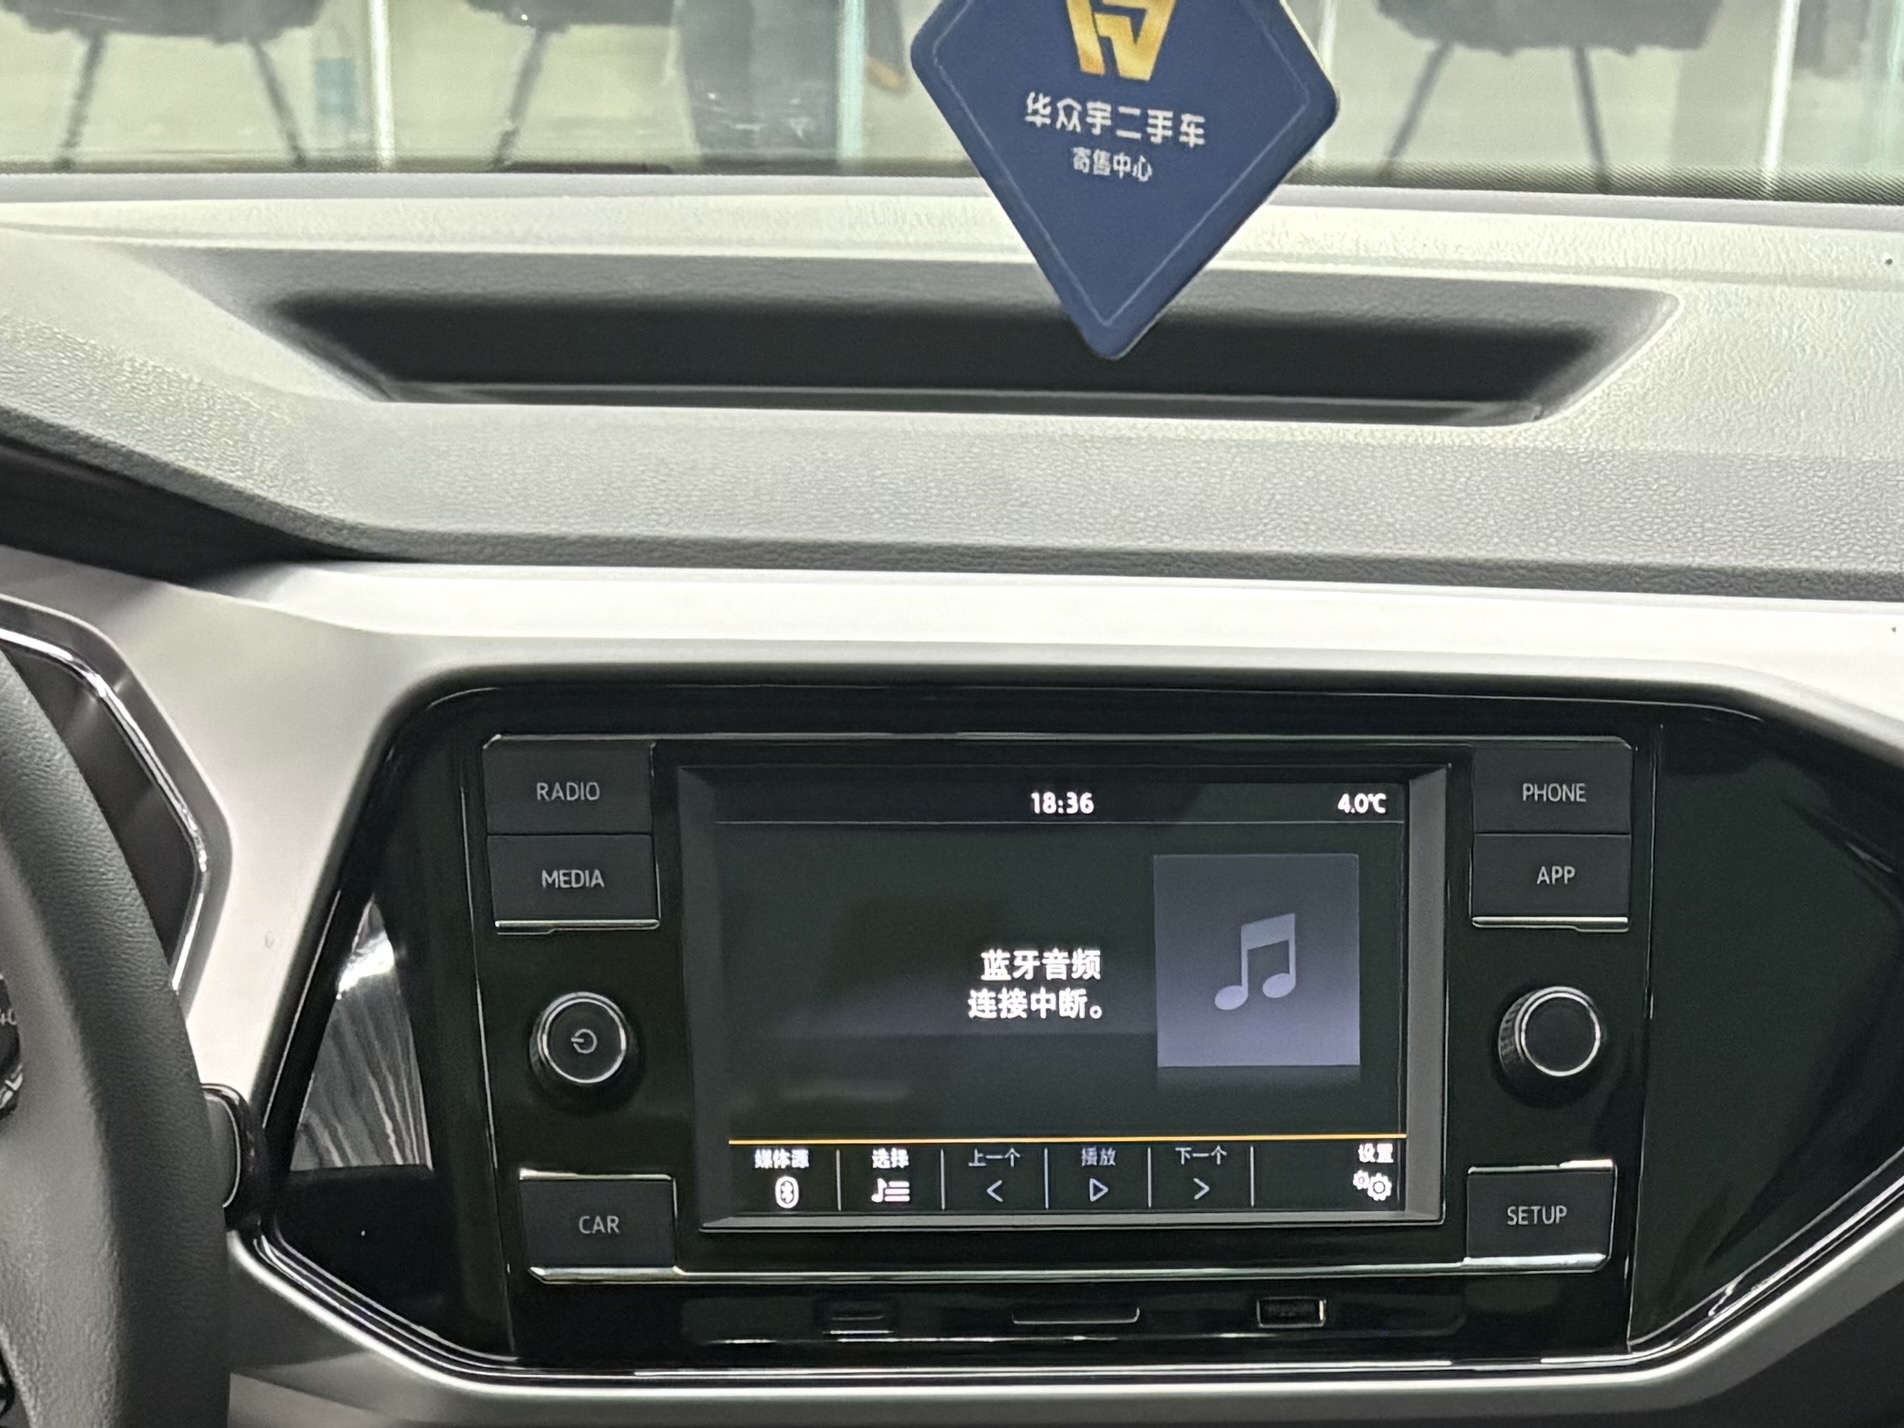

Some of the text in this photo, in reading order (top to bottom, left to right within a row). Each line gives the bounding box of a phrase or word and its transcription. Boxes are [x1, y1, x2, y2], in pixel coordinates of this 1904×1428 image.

[1024, 91, 1206, 148] 华众宇二手车
[1072, 146, 1153, 182] 寄售中心
[536, 782, 601, 802] RADIO
[1030, 790, 1095, 815] 18:36
[1522, 783, 1587, 803] PHONE
[541, 869, 605, 889] MEDIA
[1536, 866, 1576, 885] APP
[980, 947, 1102, 981] 蓝牙音频
[967, 985, 1103, 1019] 连接中断。
[872, 1148, 910, 1169] 选择
[968, 1147, 1022, 1168] 上一个
[1081, 1146, 1117, 1167] 播放
[1176, 1145, 1228, 1166] 下一个
[1358, 1142, 1395, 1163] 设置
[578, 1215, 620, 1236] CAR
[1506, 1205, 1568, 1226] SETUP
